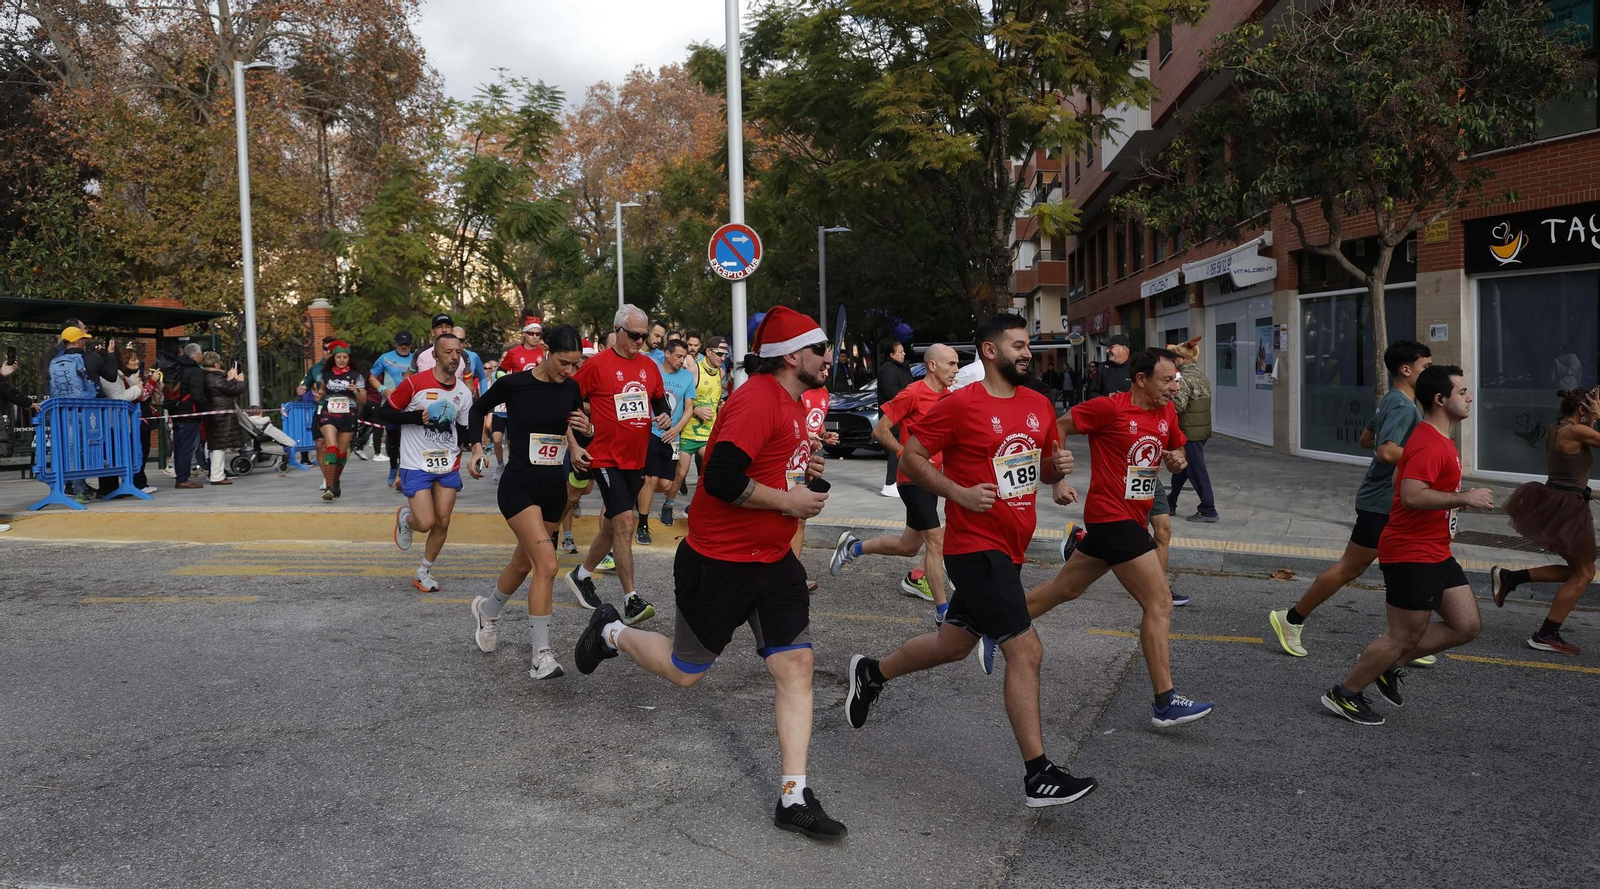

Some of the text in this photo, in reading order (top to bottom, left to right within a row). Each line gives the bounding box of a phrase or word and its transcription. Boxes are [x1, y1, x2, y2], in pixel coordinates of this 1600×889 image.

[710, 257, 760, 278] EXCEPTO BUS
[1233, 266, 1273, 274] VITALDENT
[619, 401, 645, 412] 431
[538, 445, 559, 458] 49
[426, 457, 449, 468] 318
[1002, 465, 1037, 487] 189
[1131, 478, 1156, 492] 260
